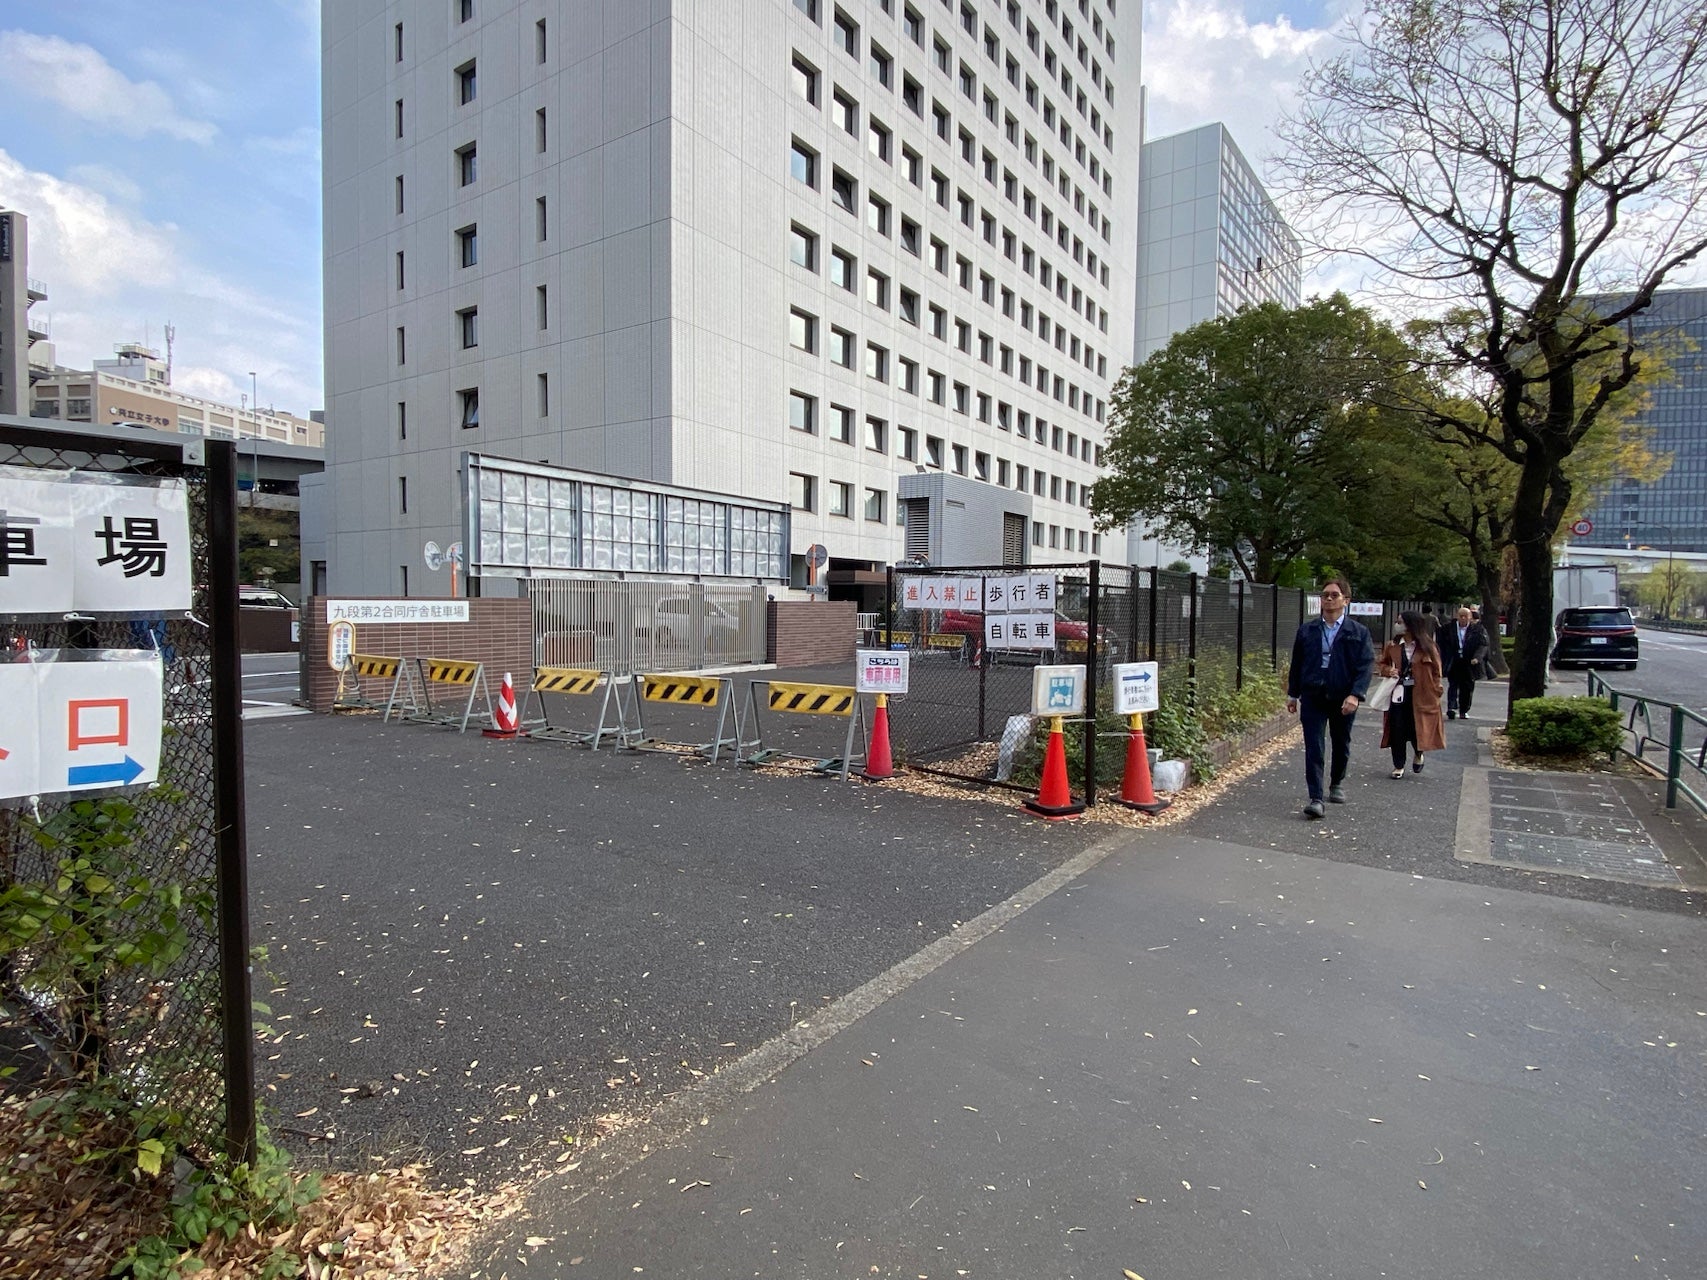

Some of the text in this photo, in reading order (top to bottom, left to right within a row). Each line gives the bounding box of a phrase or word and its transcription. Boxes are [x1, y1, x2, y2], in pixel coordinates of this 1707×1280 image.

[1577, 523, 1588, 532] 40
[906, 584, 978, 602] 進入禁止
[990, 582, 1051, 603] 歩行者
[333, 605, 465, 619] 九段第2合同庁舎駐車場
[991, 622, 1050, 640] 自転車
[869, 658, 898, 666] こちらは
[865, 667, 901, 684] 車両専用
